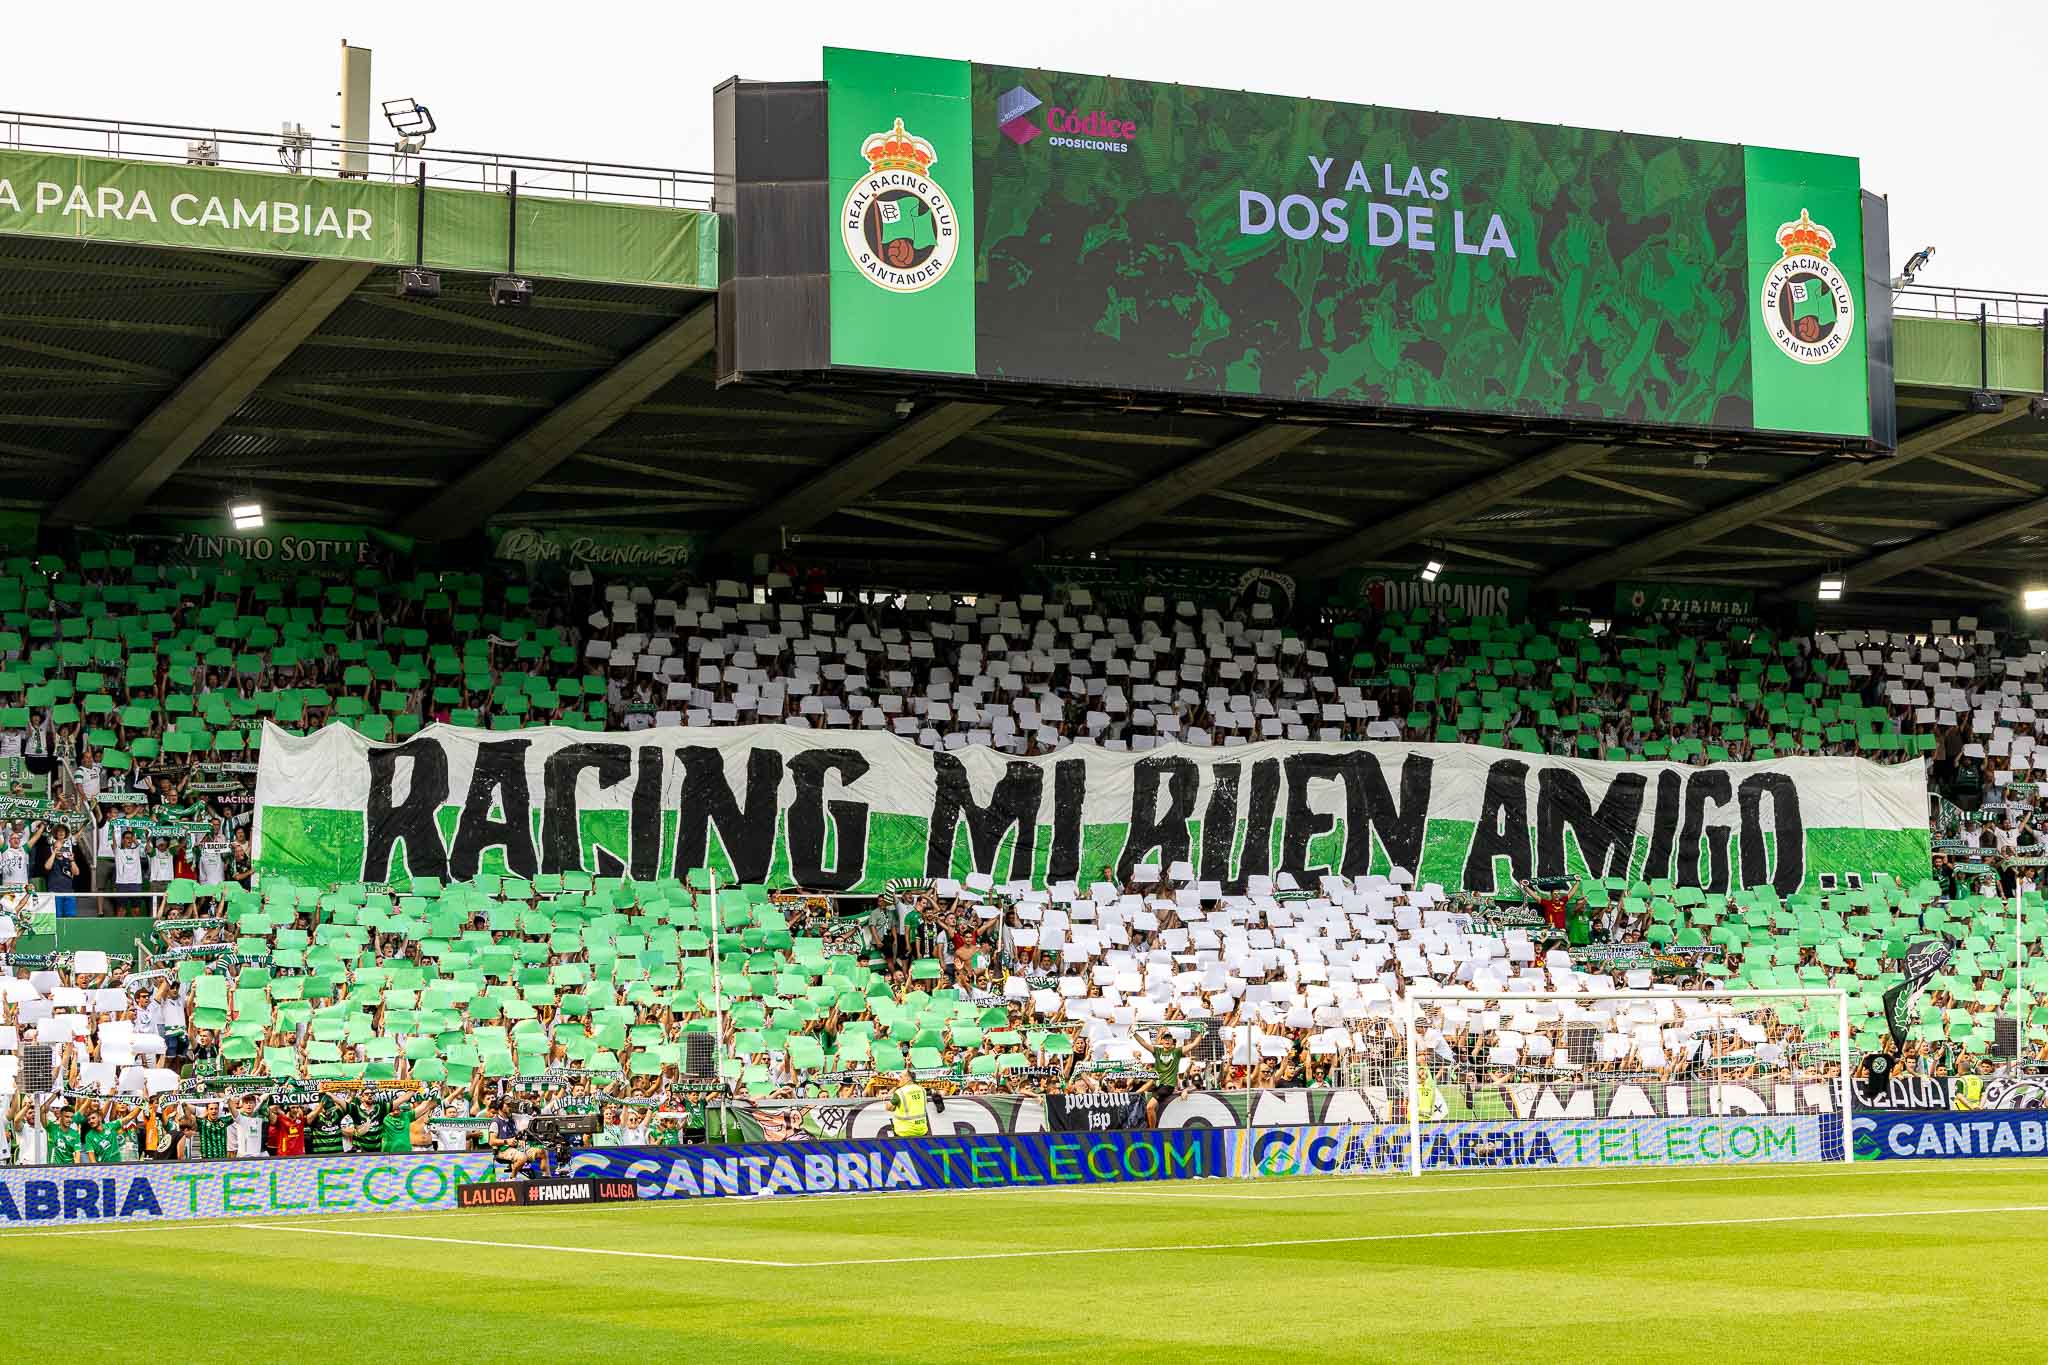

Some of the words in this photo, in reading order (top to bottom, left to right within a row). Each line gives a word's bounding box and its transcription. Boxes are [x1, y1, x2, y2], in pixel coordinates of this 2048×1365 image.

[1047, 105, 1137, 140] Códice
[1049, 136, 1128, 153] OPOSICIONES
[1308, 155, 1334, 189] Y
[1344, 160, 1372, 193] A
[1384, 163, 1449, 201] LAS
[36, 181, 157, 223] PARA
[169, 193, 373, 241] CAMBIAR
[848, 191, 870, 230] REAL
[869, 174, 929, 194] RACING
[930, 195, 952, 237] CLUB
[1239, 189, 1349, 244] DOS
[1368, 202, 1436, 251] DE
[1454, 210, 1517, 258] LA
[860, 252, 943, 285] SANTANDER
[1767, 274, 1784, 309] REAL
[1783, 258, 1830, 278] RACING
[1830, 277, 1849, 315] CLUB
[1776, 329, 1842, 358] SANTANDER
[217, 796, 255, 804] RACING
[363, 737, 872, 891] RACING
[926, 751, 1086, 885] MI
[1113, 750, 1435, 893] BUEN
[272, 1093, 320, 1104] RACING
[672, 1083, 725, 1091] RACING
[1308, 1134, 1559, 1170] CANTABRIA
[1561, 1123, 1798, 1164] TELECOM
[1888, 1121, 2048, 1156] CANTAB
[625, 1151, 923, 1199] CANTABRIA
[929, 1140, 1202, 1185] TELECOM
[463, 1187, 516, 1205] LALIGA
[528, 1183, 590, 1201] #FANCAM
[600, 1183, 635, 1198] LALIGA
